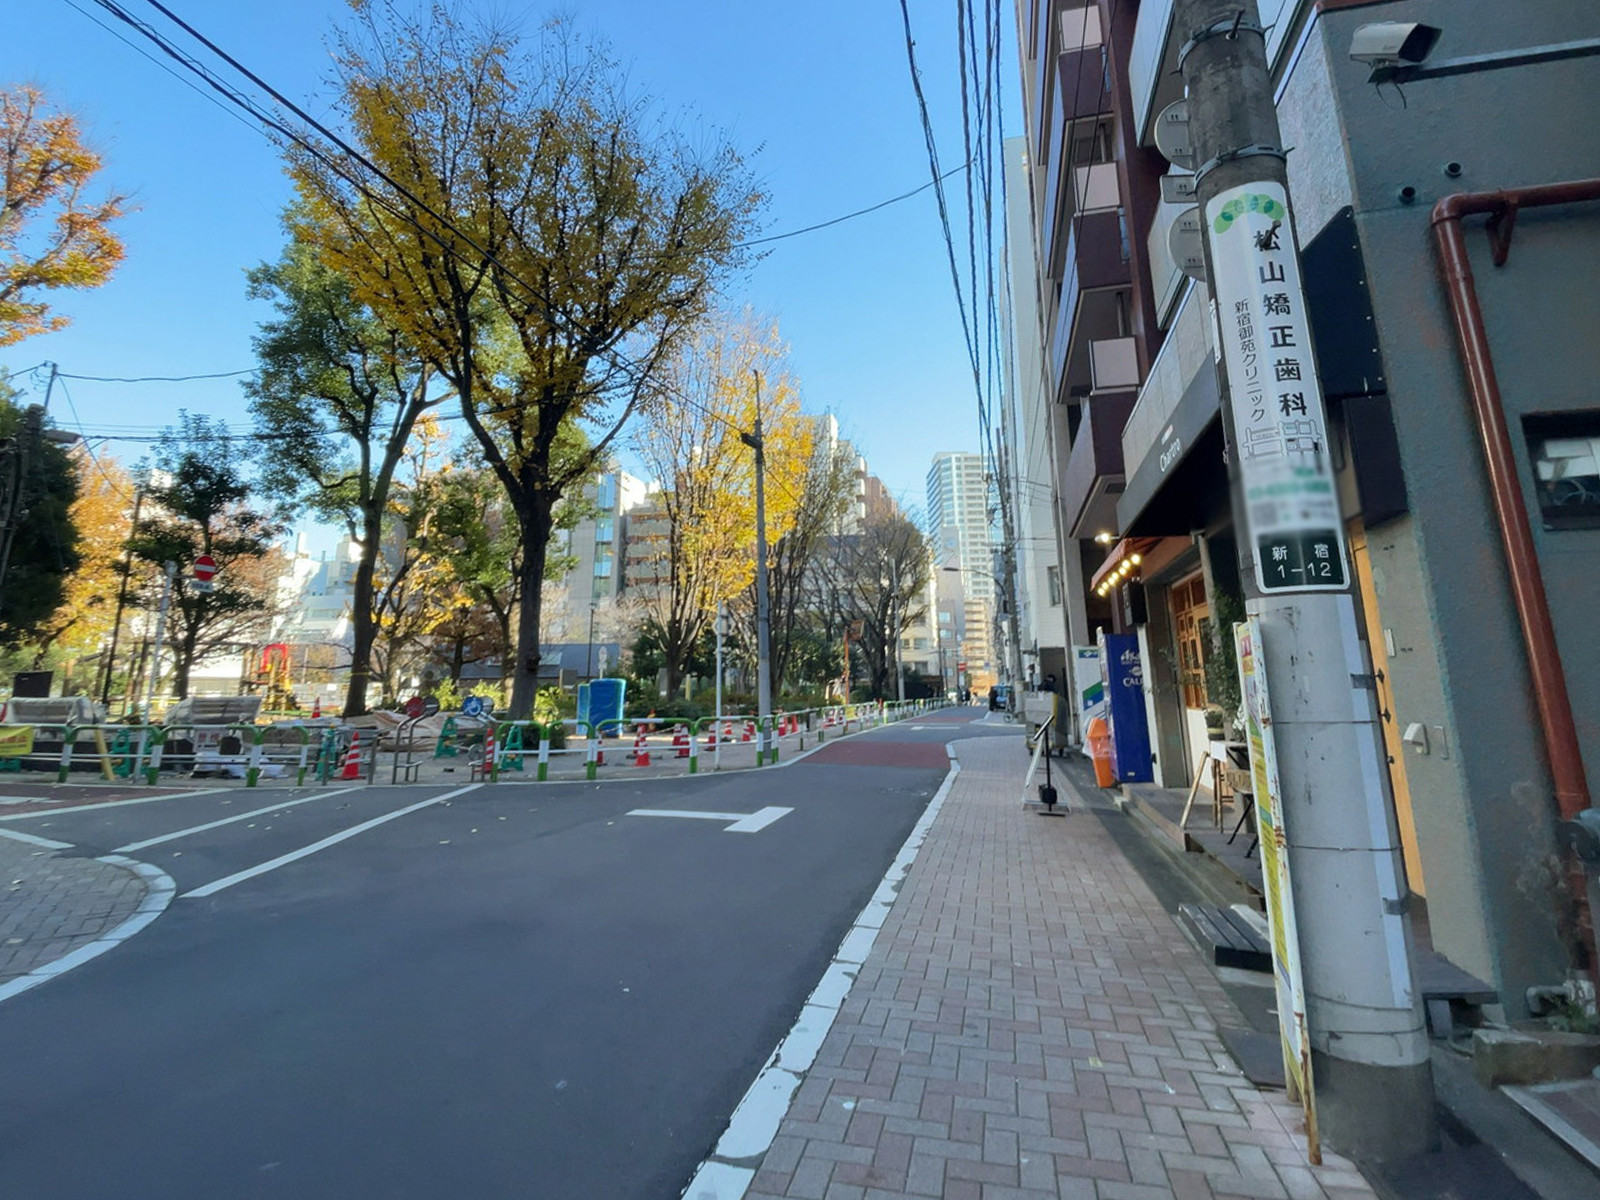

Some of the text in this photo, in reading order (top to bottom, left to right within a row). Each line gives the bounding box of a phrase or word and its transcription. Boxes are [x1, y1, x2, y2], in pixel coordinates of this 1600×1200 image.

[1234, 298, 1265, 422] 新宿御苑クリニック
[1253, 230, 1307, 416] 松山矯正歯科
